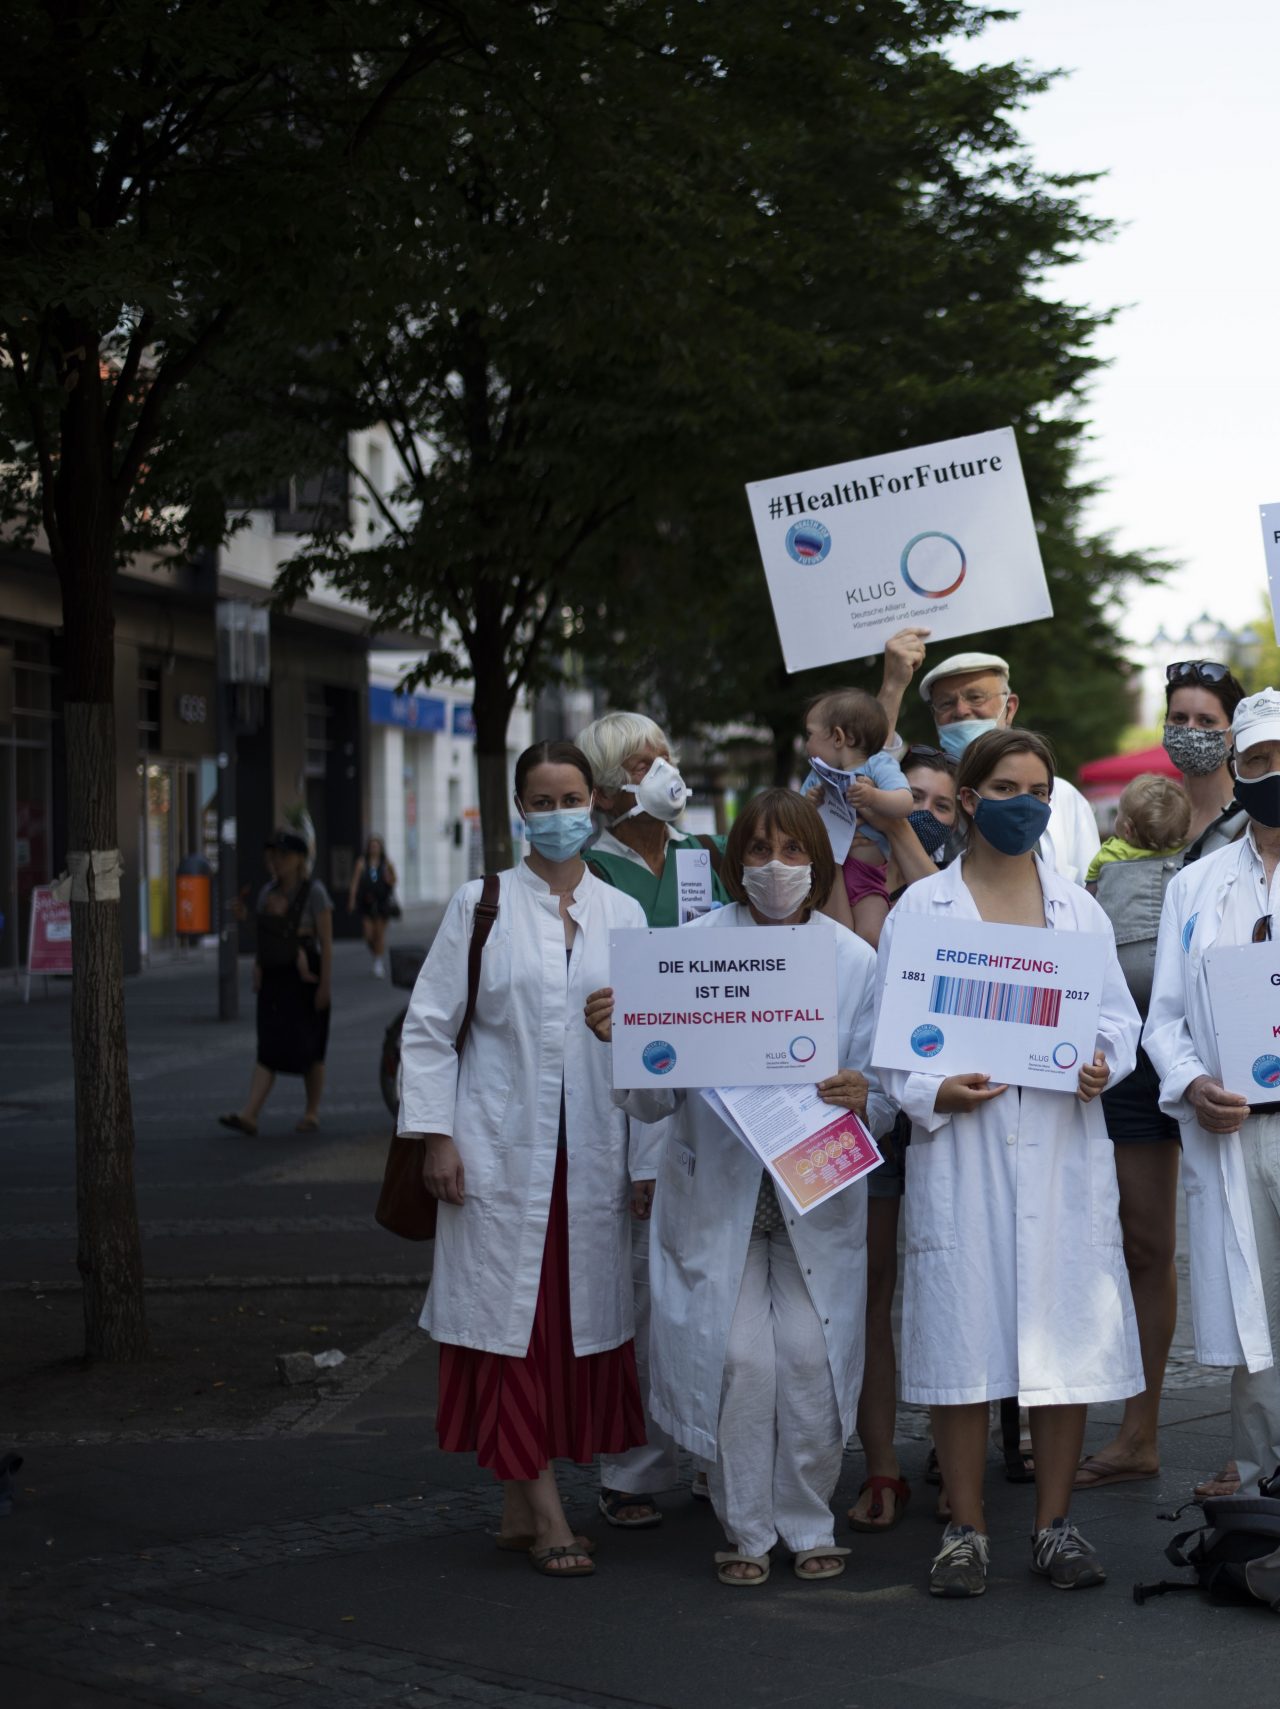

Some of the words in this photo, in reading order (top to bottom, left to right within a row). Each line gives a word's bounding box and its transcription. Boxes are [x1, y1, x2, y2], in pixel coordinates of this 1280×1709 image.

[768, 455, 1002, 520] #HealthForFuture
[846, 581, 896, 605] KLUG
[851, 606, 884, 619] Deutsche
[885, 602, 906, 611] Allianz
[853, 614, 895, 629] Klimawandel
[896, 611, 909, 620] und
[911, 603, 949, 617] Gesundheit
[658, 960, 684, 974] DIE
[689, 958, 786, 973] KLIMAKRISE
[936, 949, 1058, 975] ERDERHITZUNG:
[901, 970, 926, 981] 1881
[695, 986, 719, 999] IST
[724, 985, 750, 998] EIN
[1065, 990, 1089, 1001] 2017
[623, 1011, 746, 1026] MEDIZINISCHER
[751, 1009, 824, 1023] NOTFALL
[1029, 1053, 1049, 1062] KLUG
